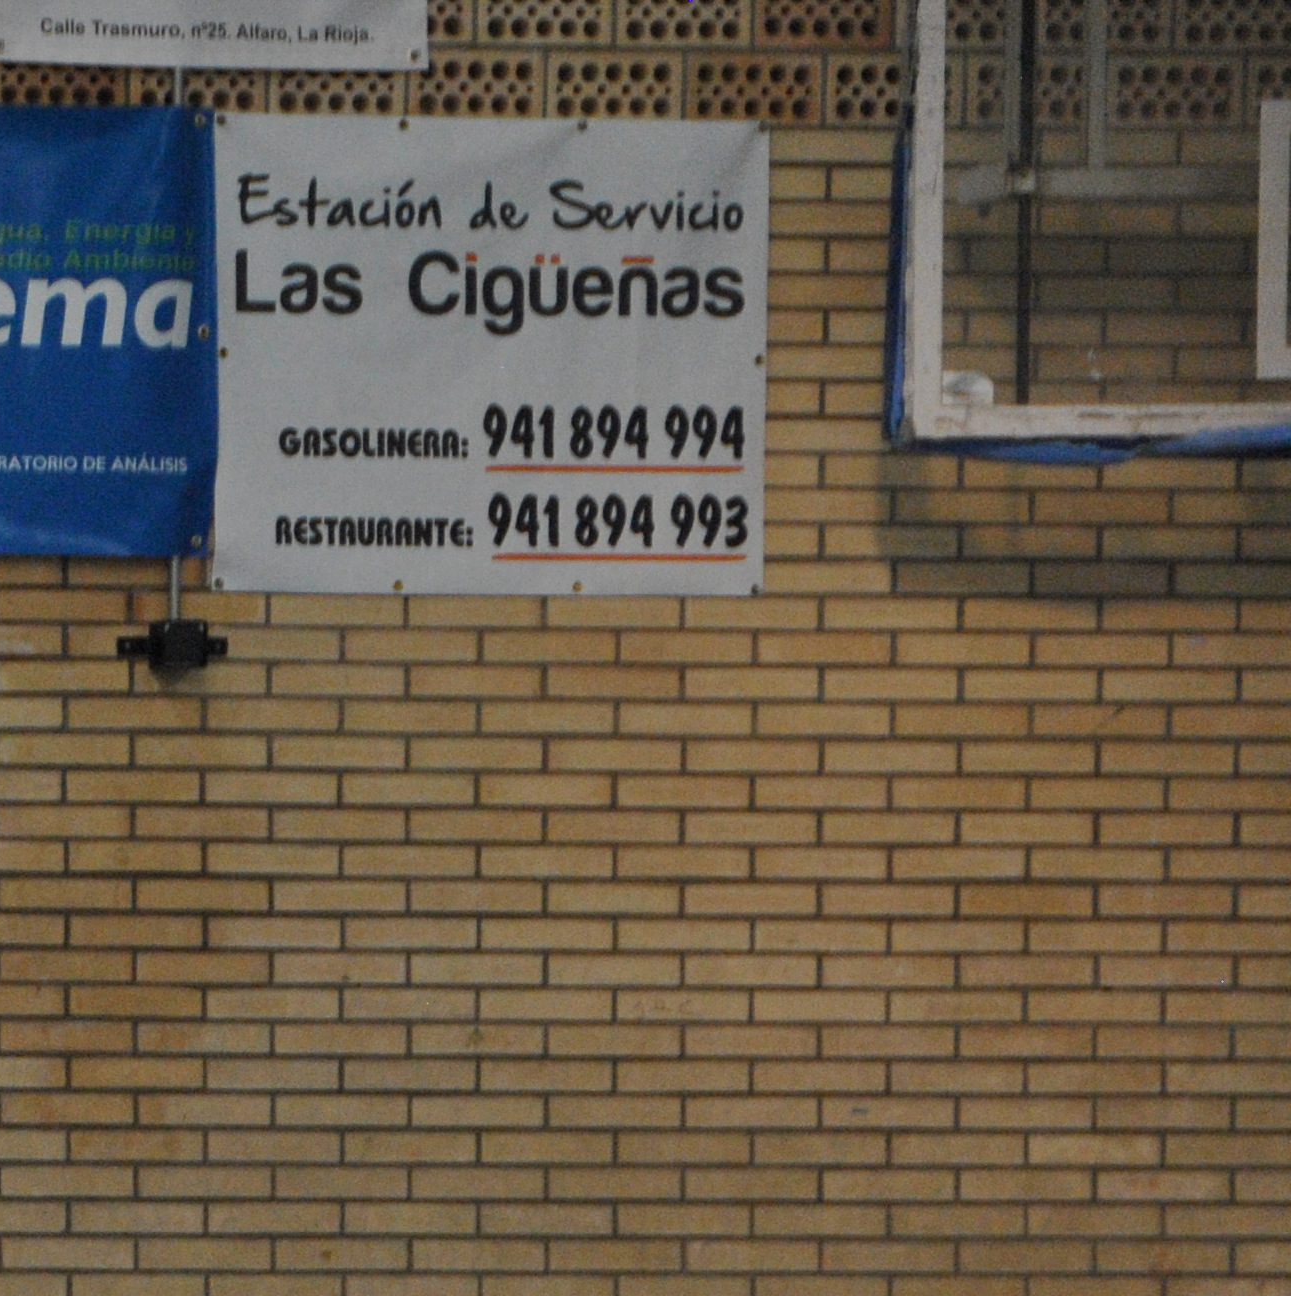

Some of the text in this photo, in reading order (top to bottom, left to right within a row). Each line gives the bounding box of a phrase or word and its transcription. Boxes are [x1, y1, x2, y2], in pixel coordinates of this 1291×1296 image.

[40, 17, 85, 37] Calle
[92, 19, 185, 40] Trasmuro,
[237, 22, 292, 43] Alfaro,
[298, 25, 319, 43] La
[324, 25, 375, 46] Rioja.
[236, 172, 745, 233] Estación de Servicio
[183, 225, 196, 247] y
[64, 249, 196, 271] Ambiente
[234, 249, 746, 336] Las Cigüeñas
[278, 404, 746, 460] GASOLINERA: 941 894 994
[83, 455, 107, 473] DE
[111, 450, 188, 474] ANÁLISIS
[275, 492, 749, 549] RESTAURANTE: 941 894 993
